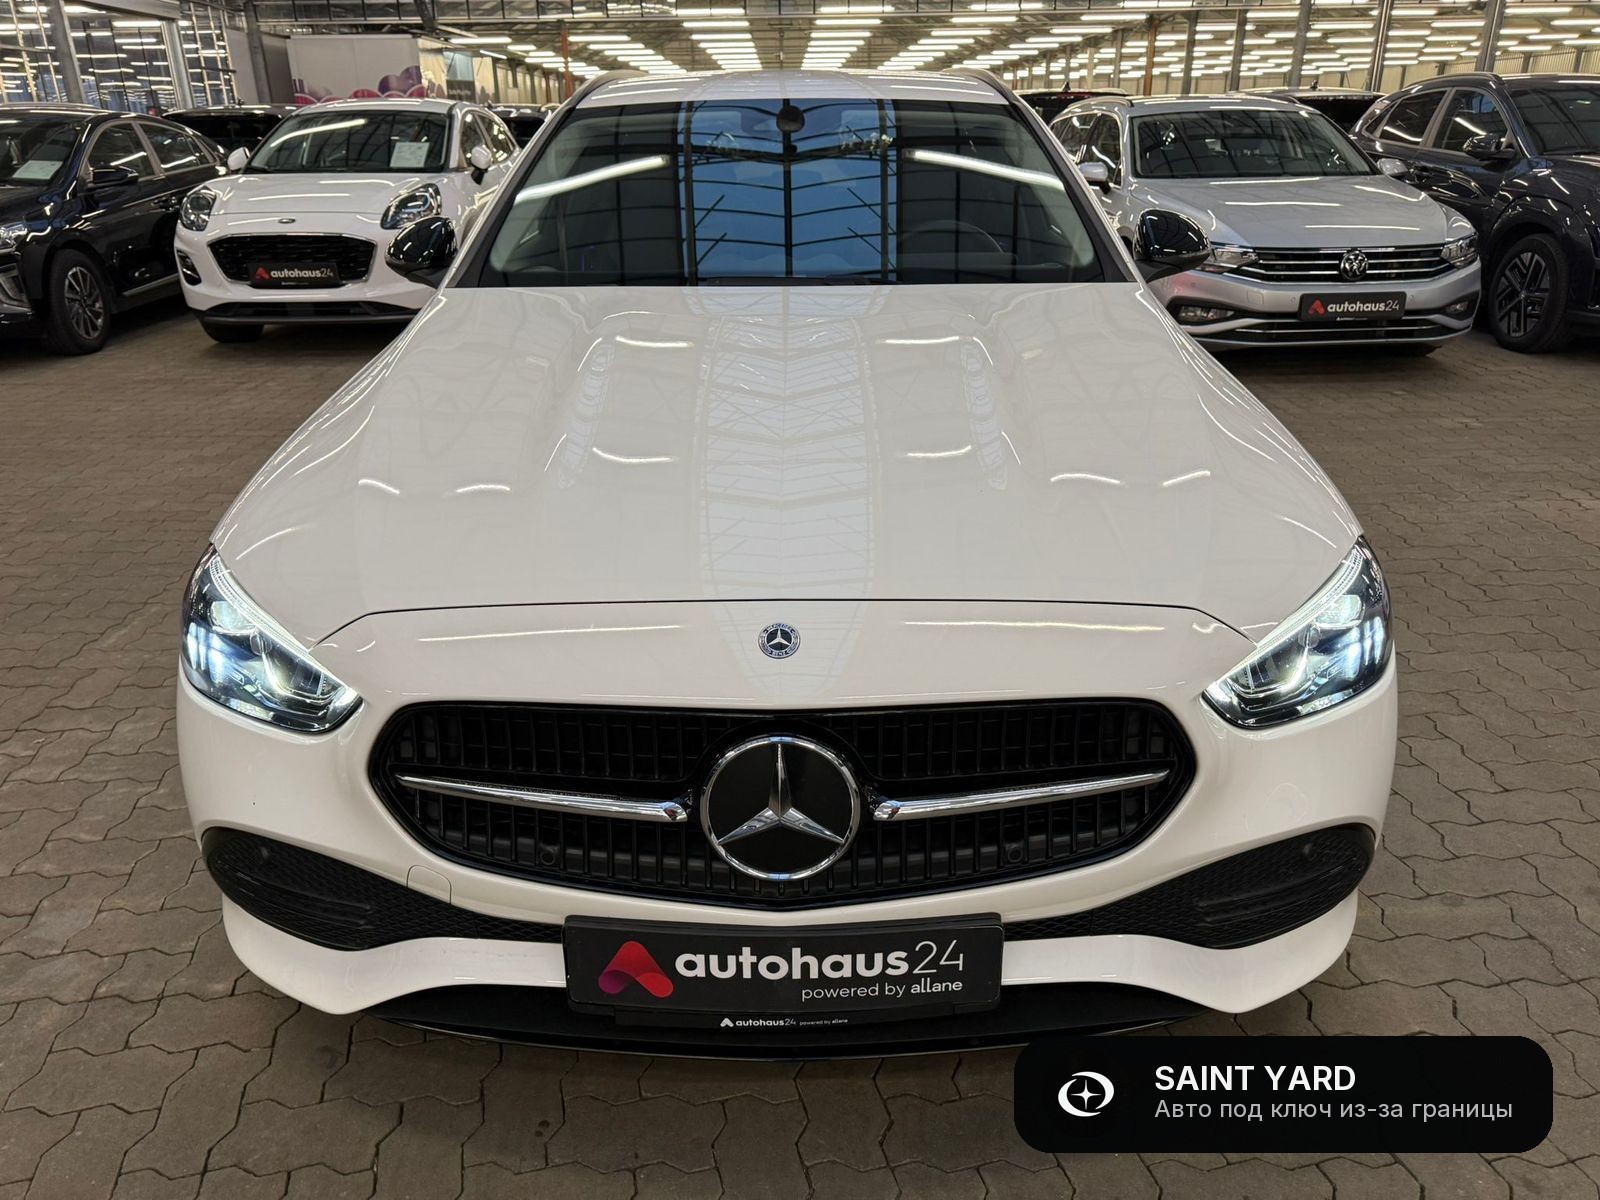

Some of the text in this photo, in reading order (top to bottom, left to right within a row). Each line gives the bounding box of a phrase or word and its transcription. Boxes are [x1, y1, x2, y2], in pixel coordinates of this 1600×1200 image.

[270, 267, 334, 278] autohaus24
[1327, 299, 1400, 313] autohaus24
[675, 939, 965, 980] autohaus24
[801, 977, 963, 1002] powered by allane
[735, 1018, 797, 1027] autohaus24
